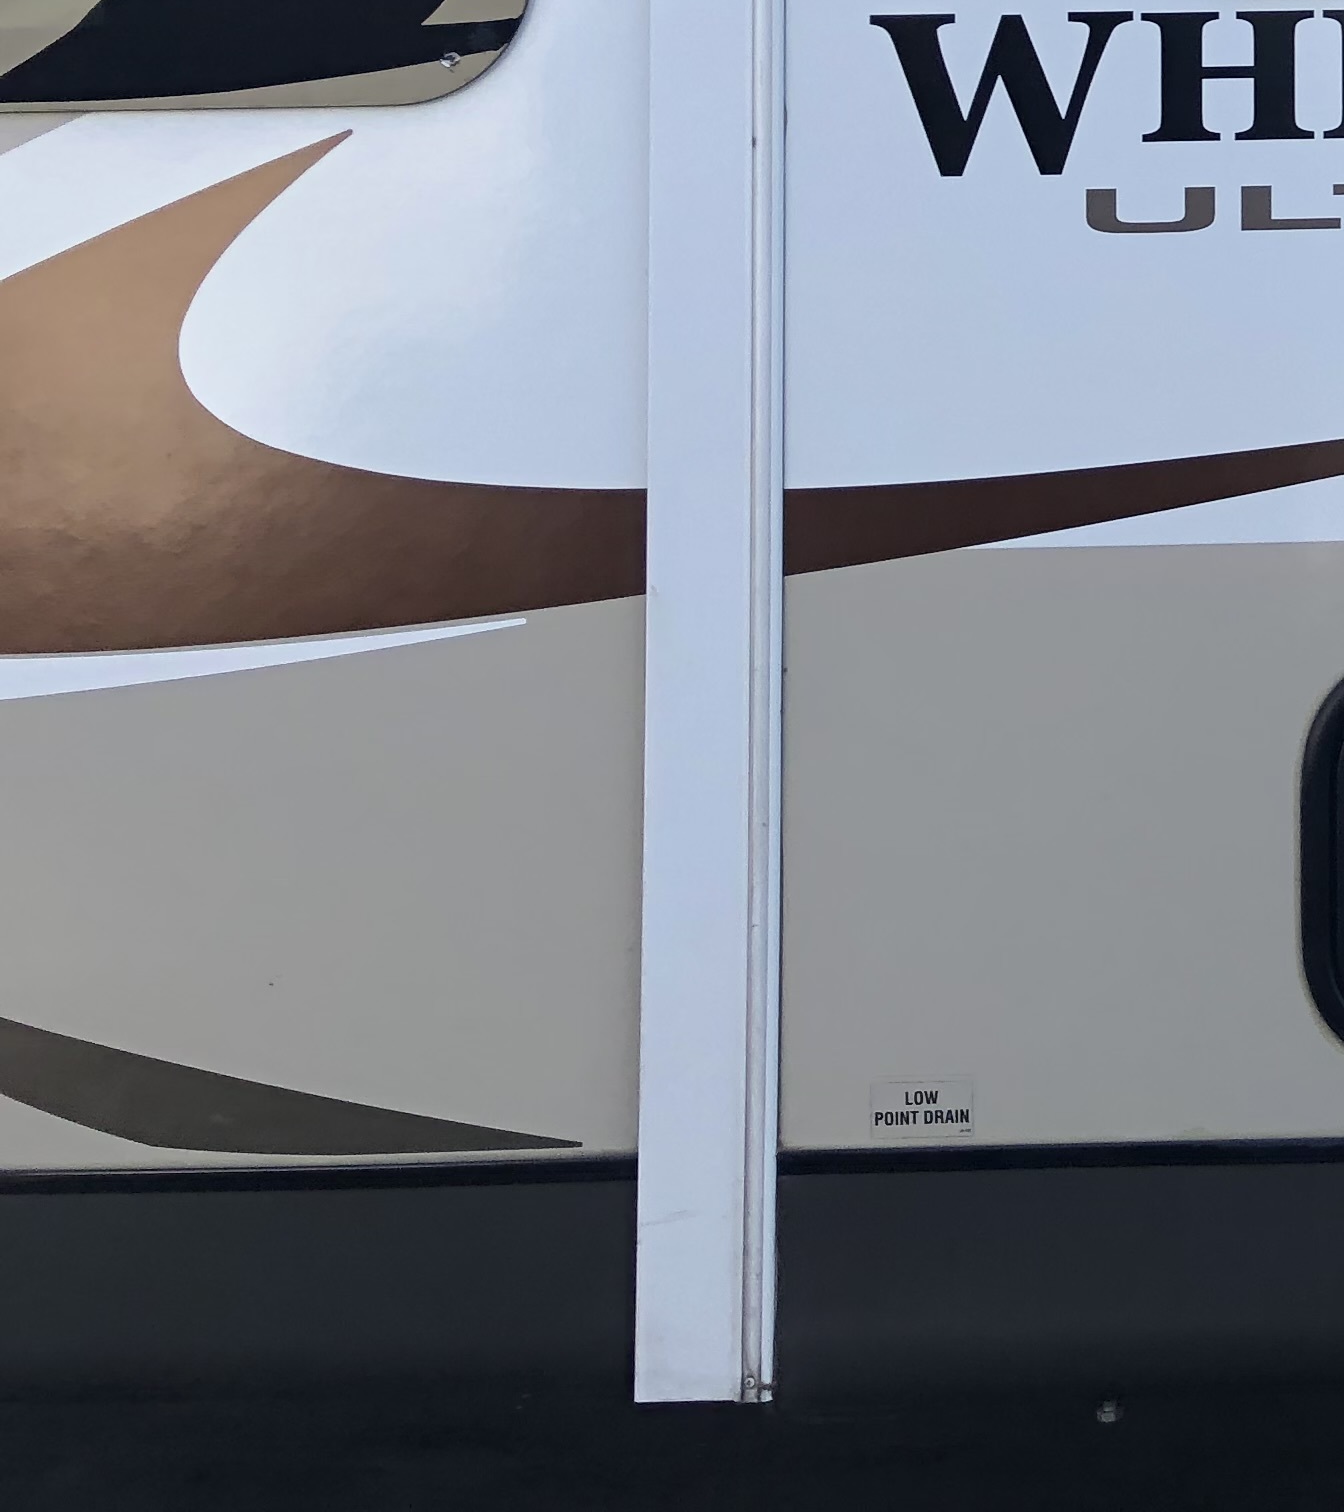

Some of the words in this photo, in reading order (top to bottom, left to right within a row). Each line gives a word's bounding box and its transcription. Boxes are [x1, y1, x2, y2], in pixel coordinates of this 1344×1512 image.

[904, 1090, 938, 1105] LOW
[874, 1110, 919, 1126] POINT
[923, 1108, 970, 1124] DRAIN
